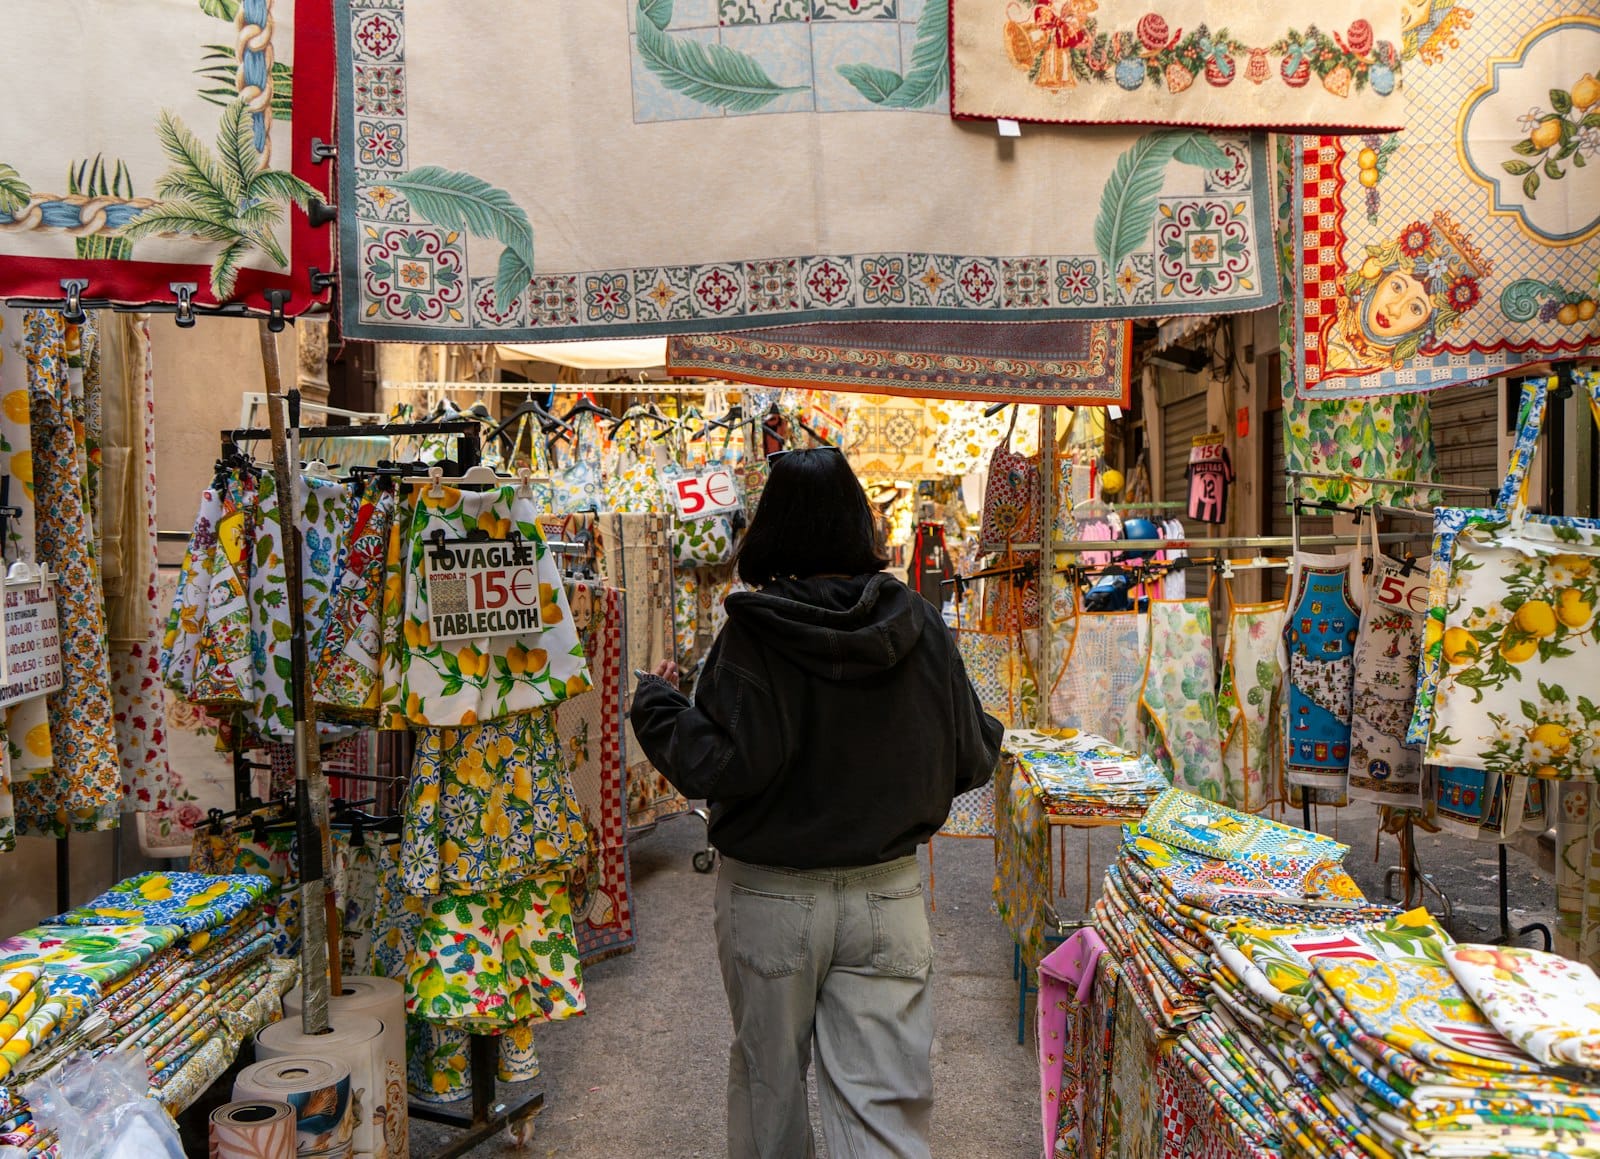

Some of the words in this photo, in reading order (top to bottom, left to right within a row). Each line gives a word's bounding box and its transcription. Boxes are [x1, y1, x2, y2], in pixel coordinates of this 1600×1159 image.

[677, 471, 736, 514] 5€
[1203, 479, 1216, 499] 12
[470, 567, 537, 609] 15€
[1378, 577, 1429, 614] 5€
[433, 608, 539, 637] TABLECLOTH
